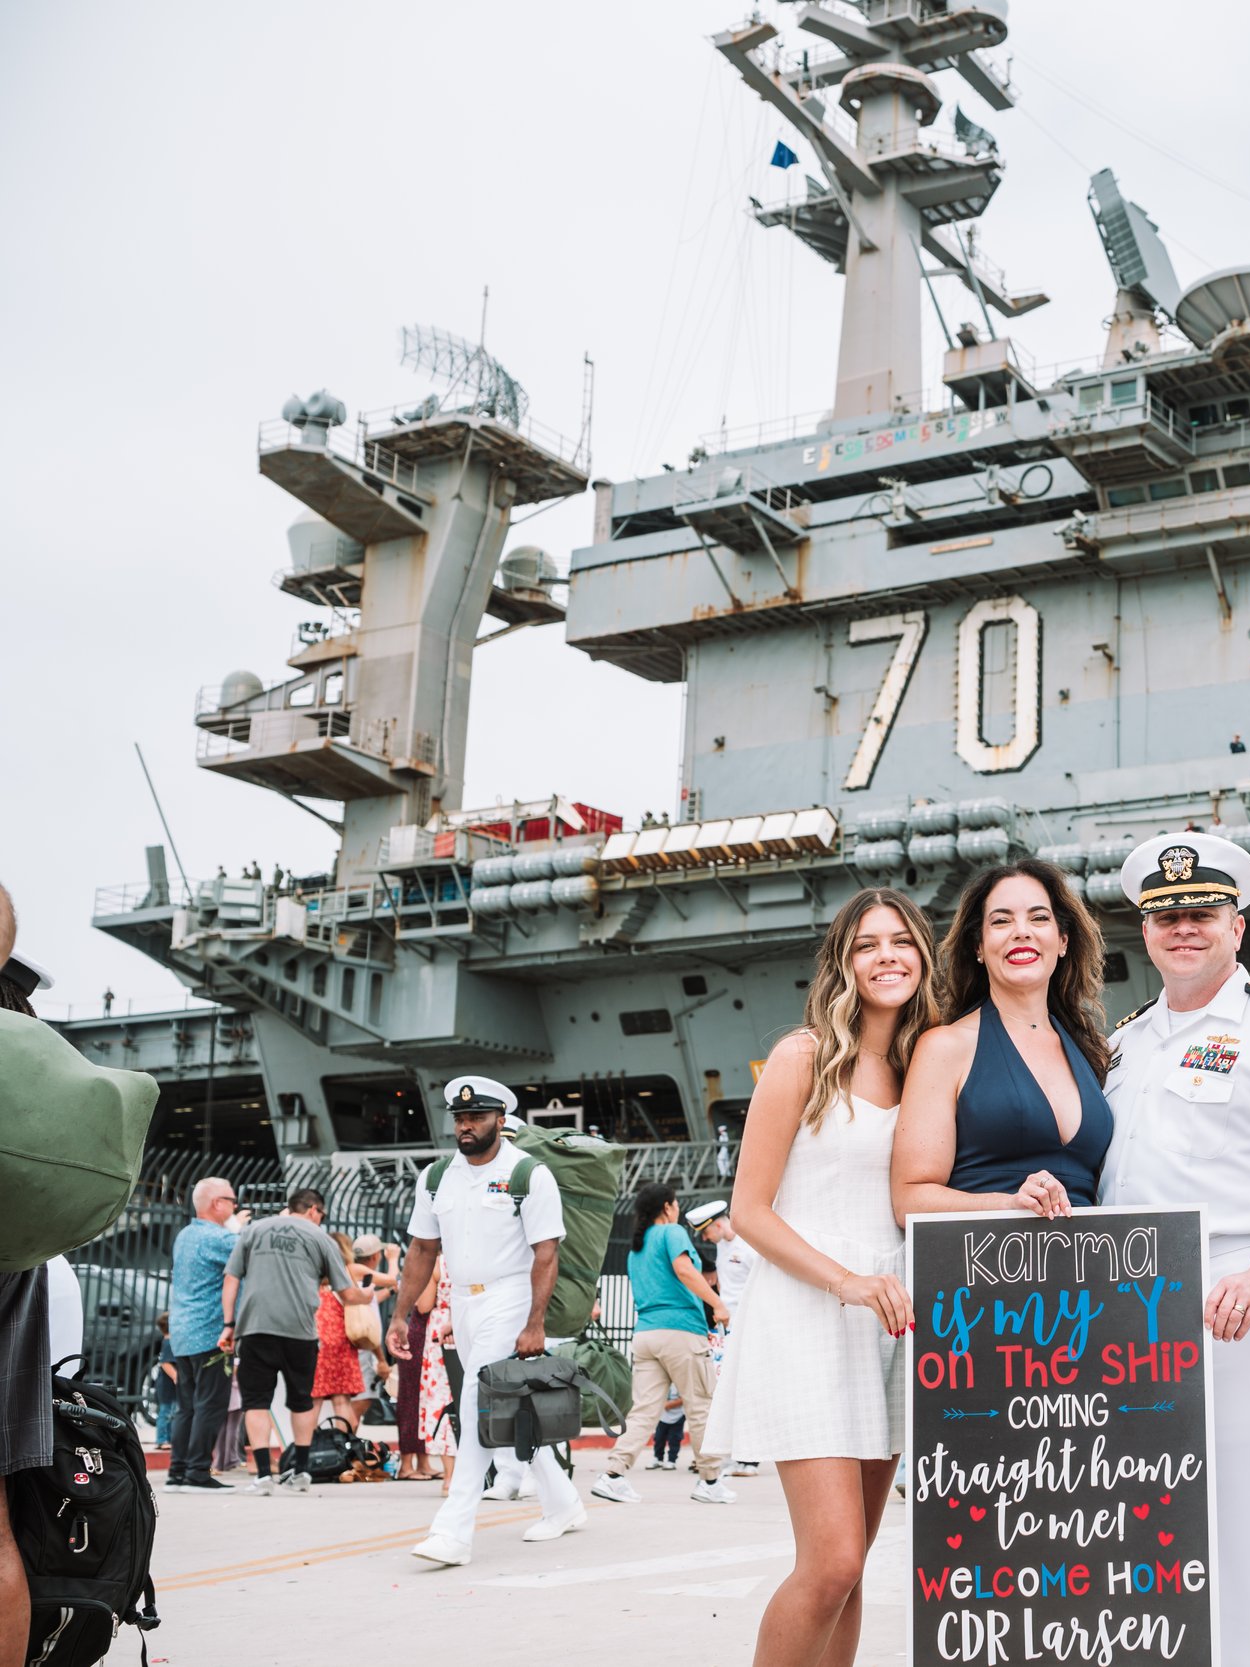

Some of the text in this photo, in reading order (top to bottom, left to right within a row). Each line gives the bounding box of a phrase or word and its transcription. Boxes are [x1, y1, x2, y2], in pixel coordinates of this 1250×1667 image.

[843, 596, 1043, 791] 70
[270, 1233, 297, 1253] VANS
[964, 1227, 1158, 1286] karma
[932, 1287, 985, 1356] is
[994, 1290, 1104, 1361] my
[918, 1350, 974, 1390] on
[996, 1345, 1079, 1388] The
[1008, 1393, 1109, 1429] COMING
[917, 1435, 1202, 1503] straight home
[994, 1492, 1126, 1550] to me!
[937, 1608, 1186, 1667] CDR Larsen
